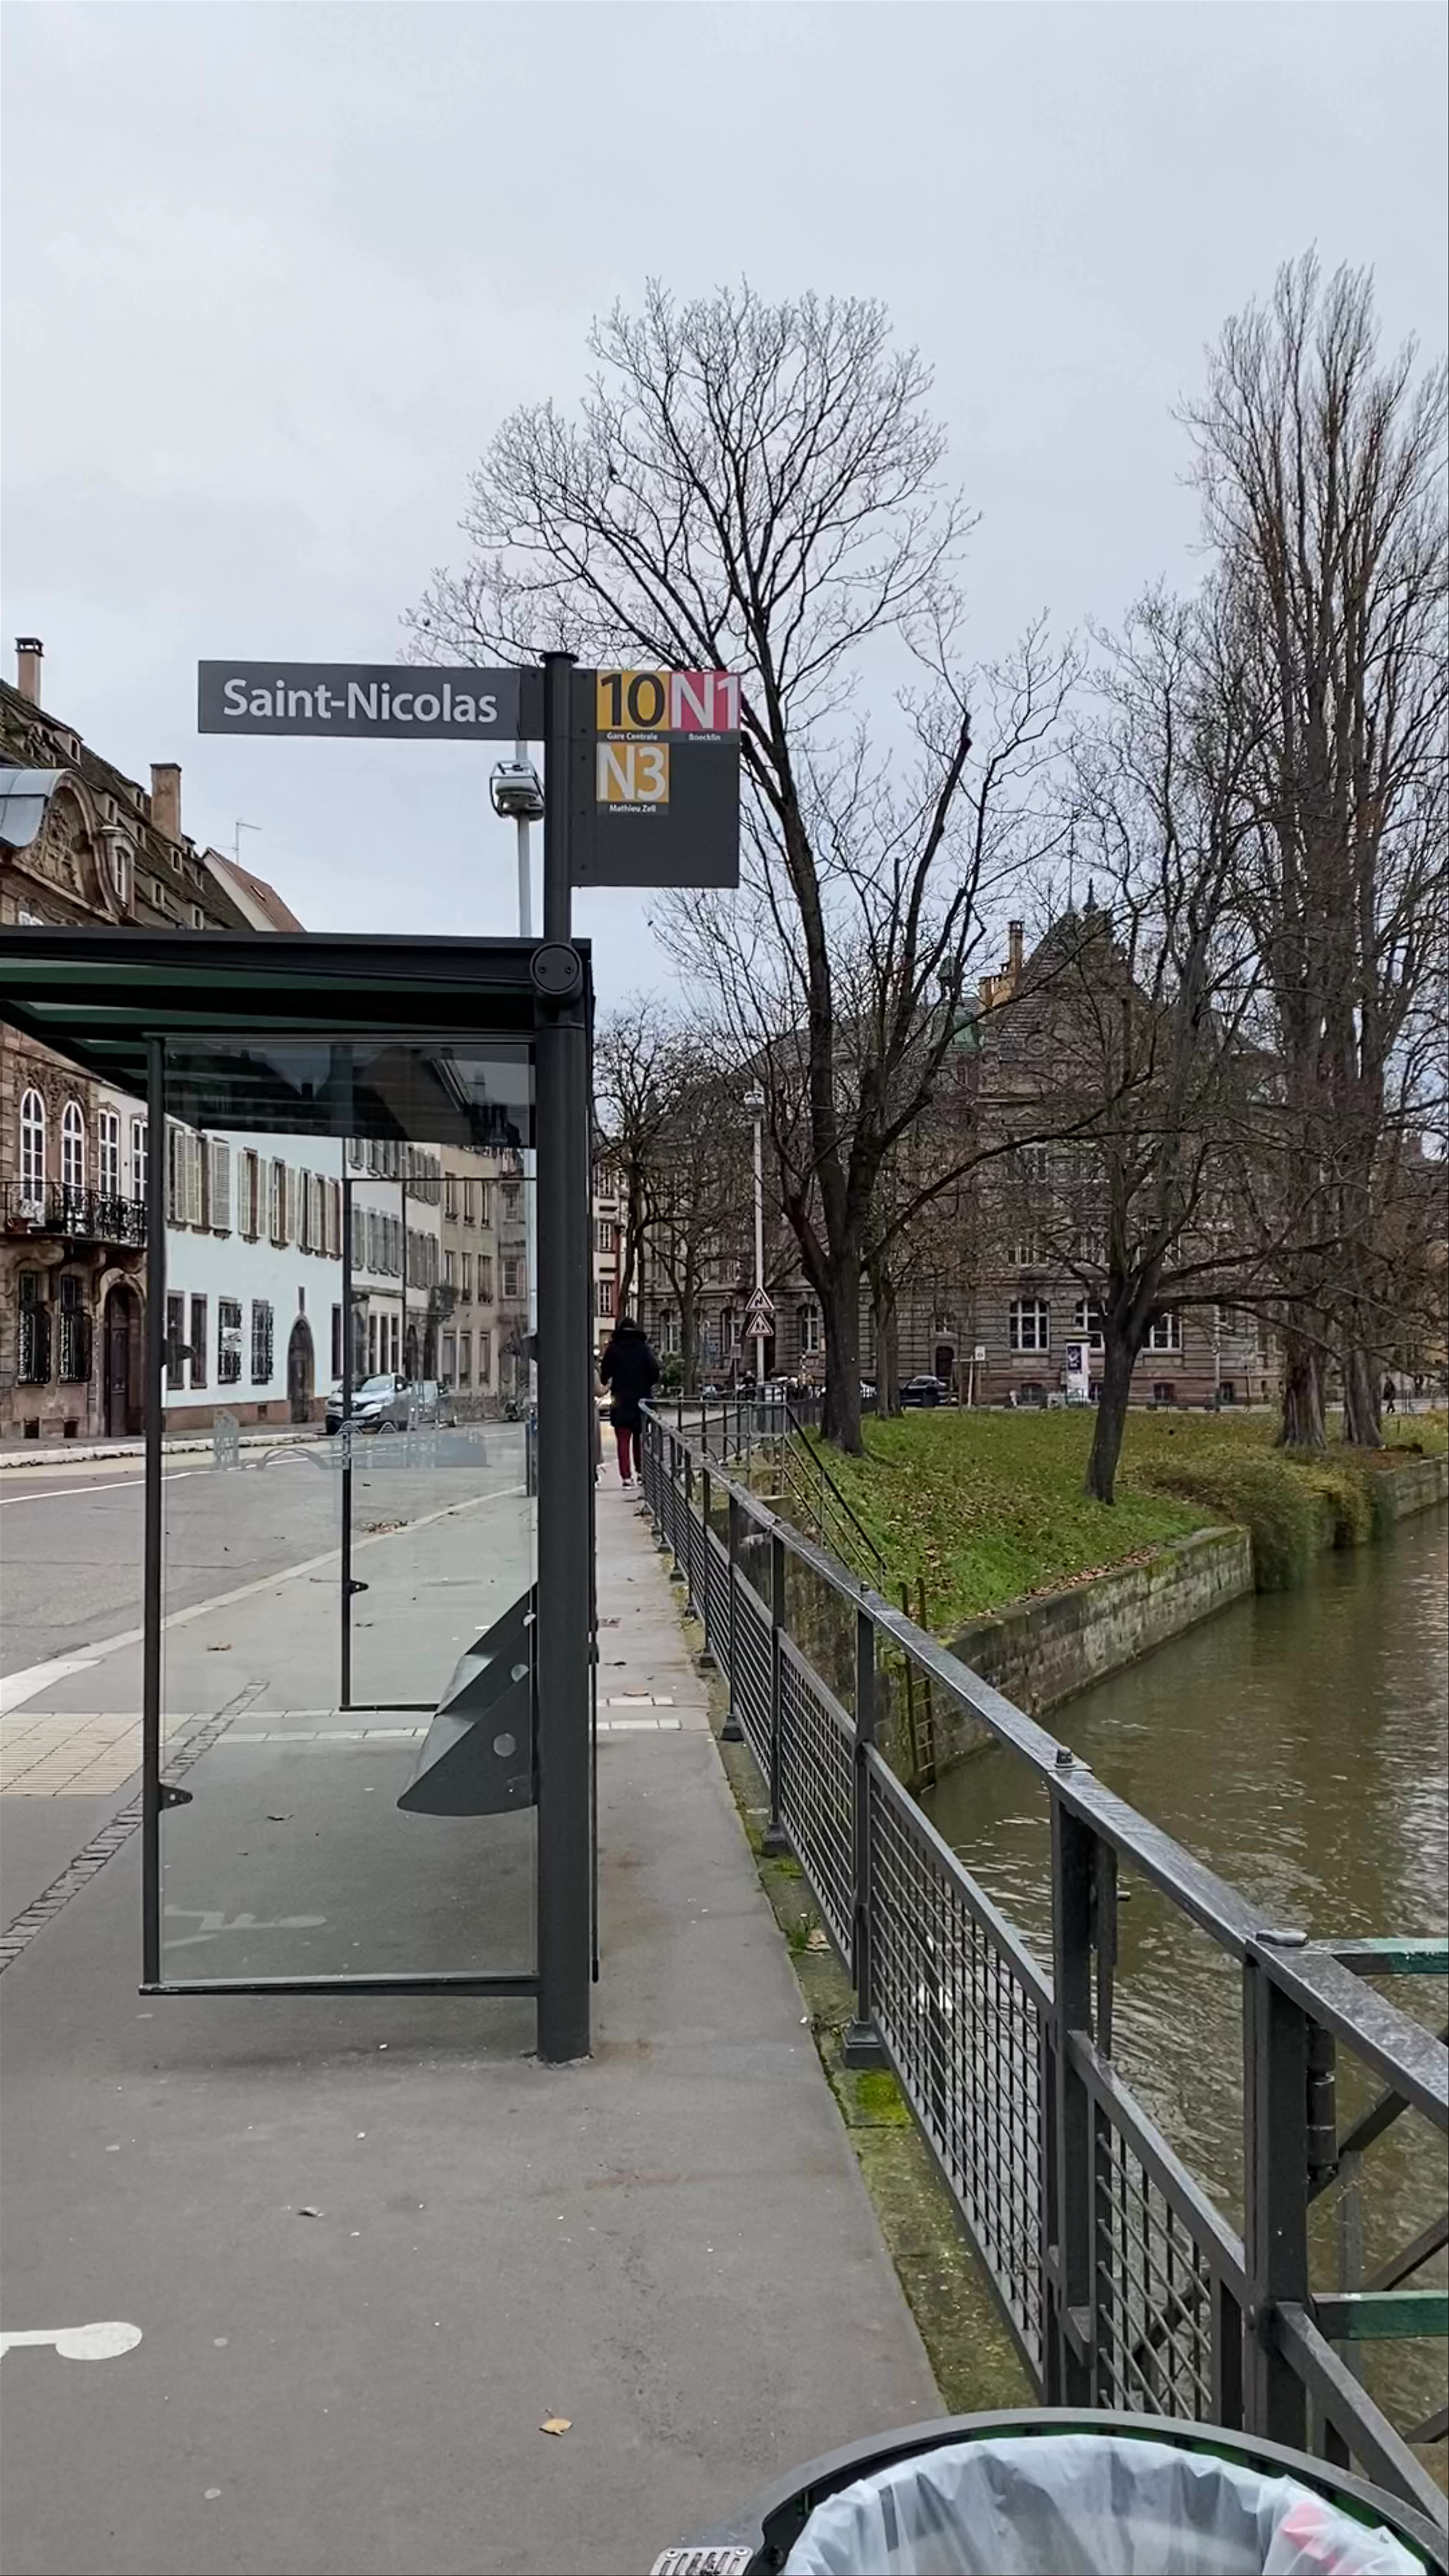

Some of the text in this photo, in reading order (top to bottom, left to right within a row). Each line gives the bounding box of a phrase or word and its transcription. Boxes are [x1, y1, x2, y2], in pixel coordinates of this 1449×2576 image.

[223, 678, 498, 723] Saint-Nicolas
[601, 674, 665, 727] 10
[671, 674, 738, 729] N1
[597, 744, 665, 801] N3
